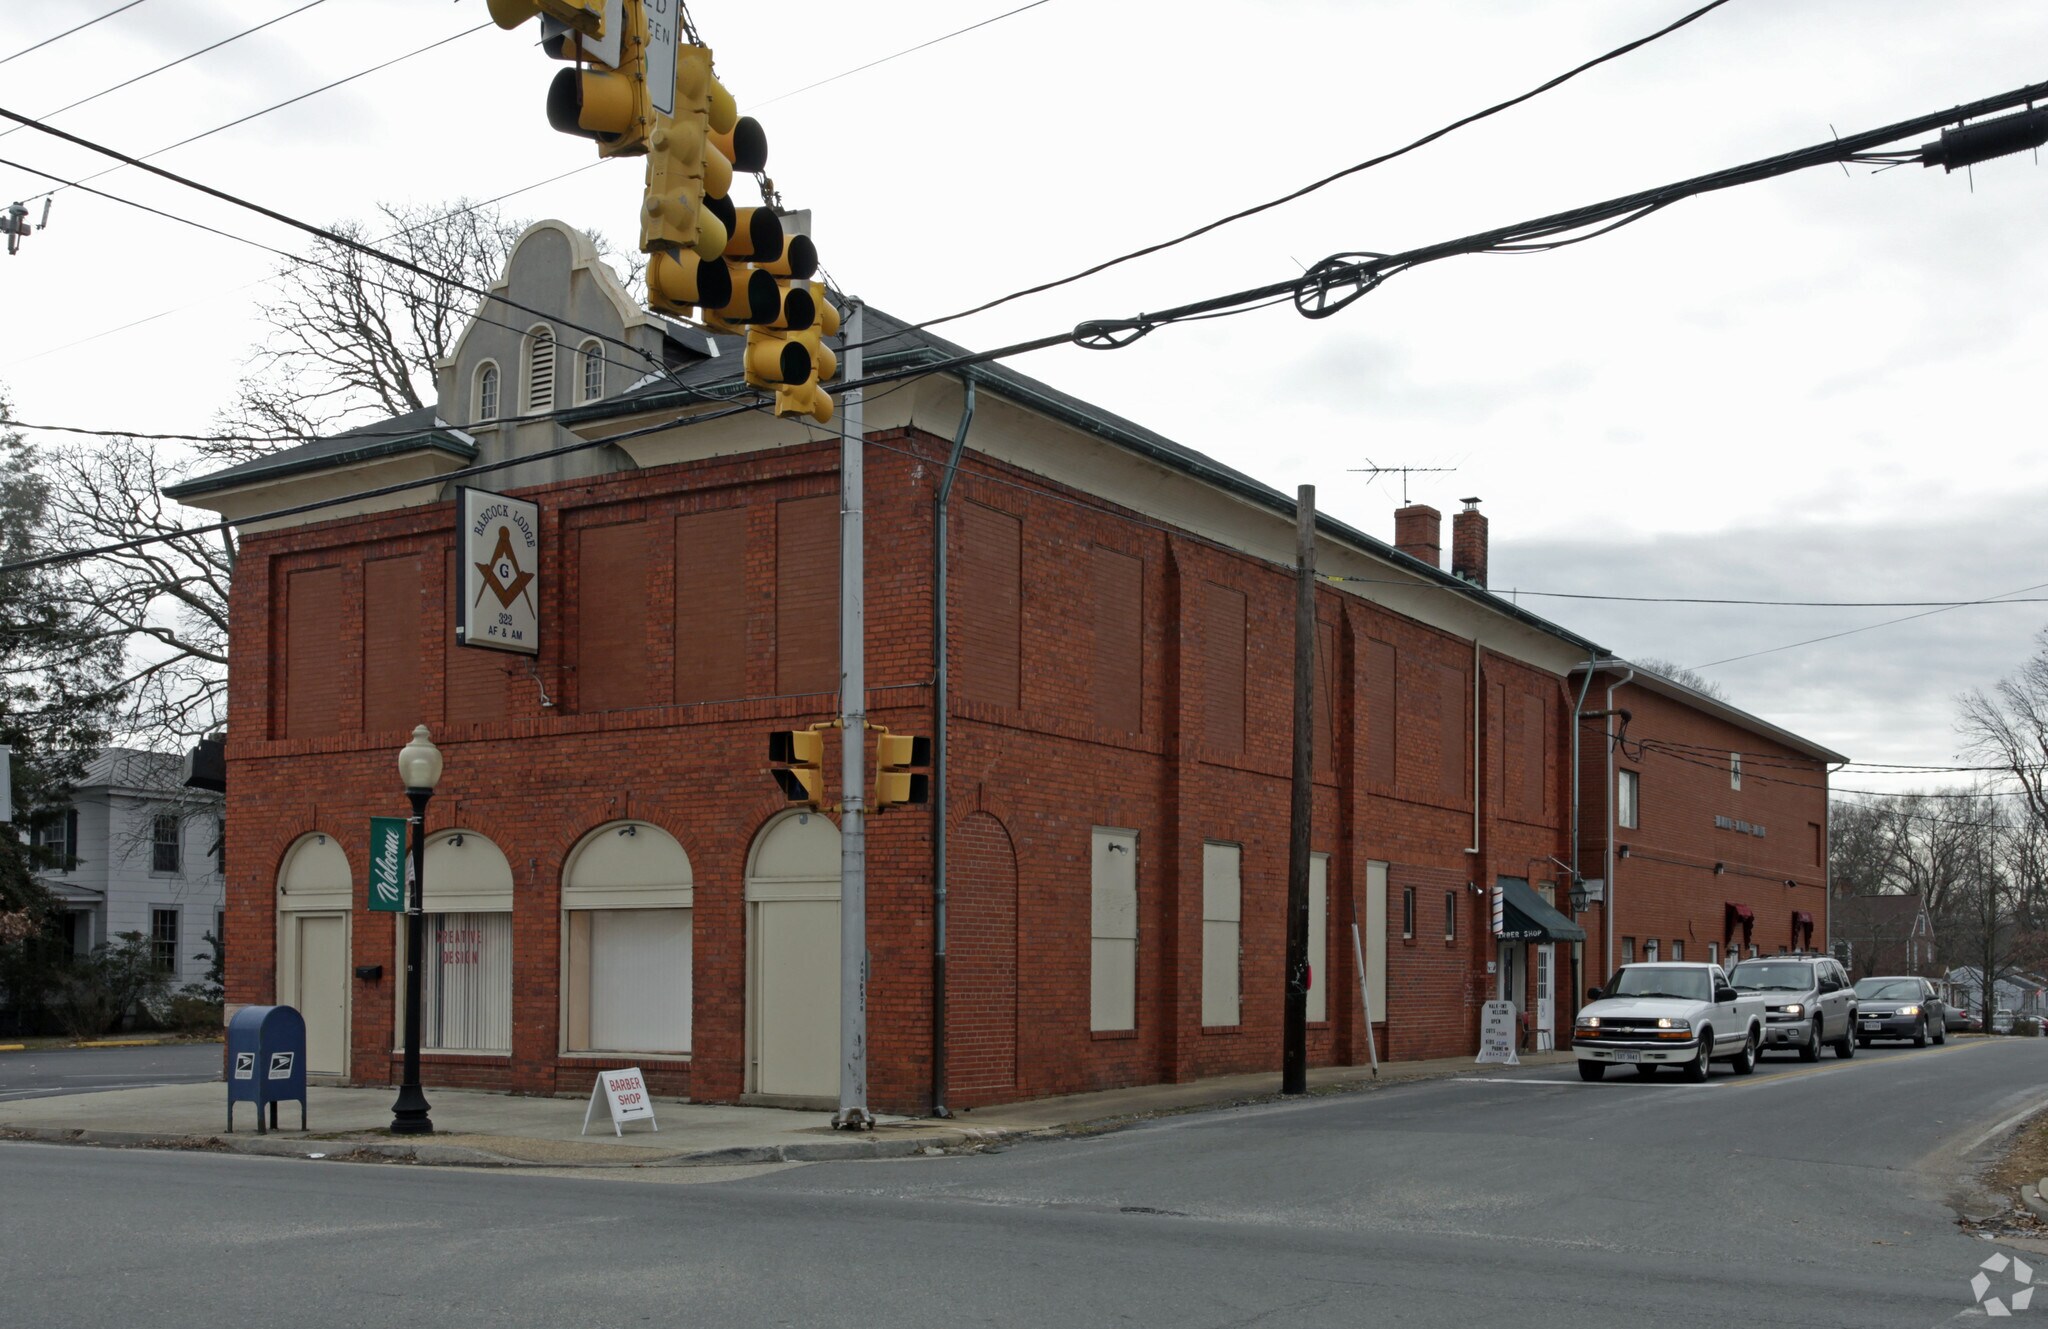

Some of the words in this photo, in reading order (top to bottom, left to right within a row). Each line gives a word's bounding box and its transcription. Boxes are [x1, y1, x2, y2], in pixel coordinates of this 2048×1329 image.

[474, 504, 509, 536] BABCOCK
[513, 510, 536, 548] LODGE
[500, 564, 509, 578] G
[488, 625, 498, 635] AF
[501, 628, 507, 638] &
[511, 630, 523, 640] AM
[374, 827, 400, 903] Welcome
[436, 930, 482, 943] CREATIVE
[443, 951, 479, 964] DESIGN
[609, 1077, 642, 1092] BARBER
[618, 1093, 641, 1105] SHOP
